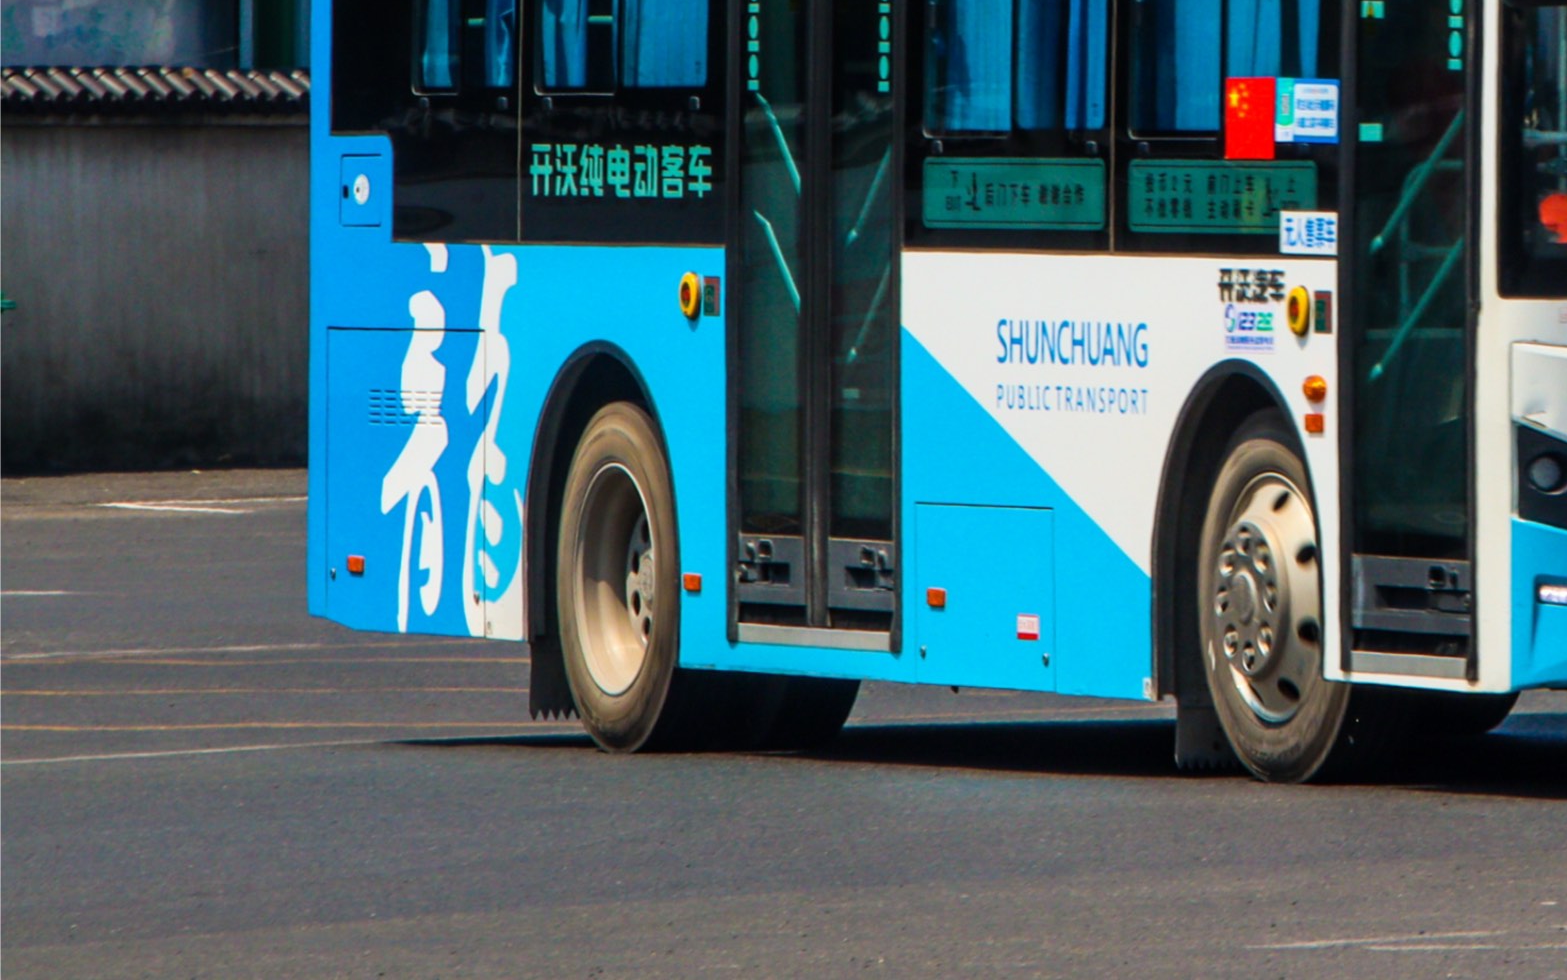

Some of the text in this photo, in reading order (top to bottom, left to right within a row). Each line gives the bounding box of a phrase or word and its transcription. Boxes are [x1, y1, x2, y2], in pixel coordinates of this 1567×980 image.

[529, 143, 713, 199] 开沃纯电动客车
[996, 318, 1149, 369] SHUNCHUANG
[996, 383, 1149, 415] PUBLIC TRANSPORT
